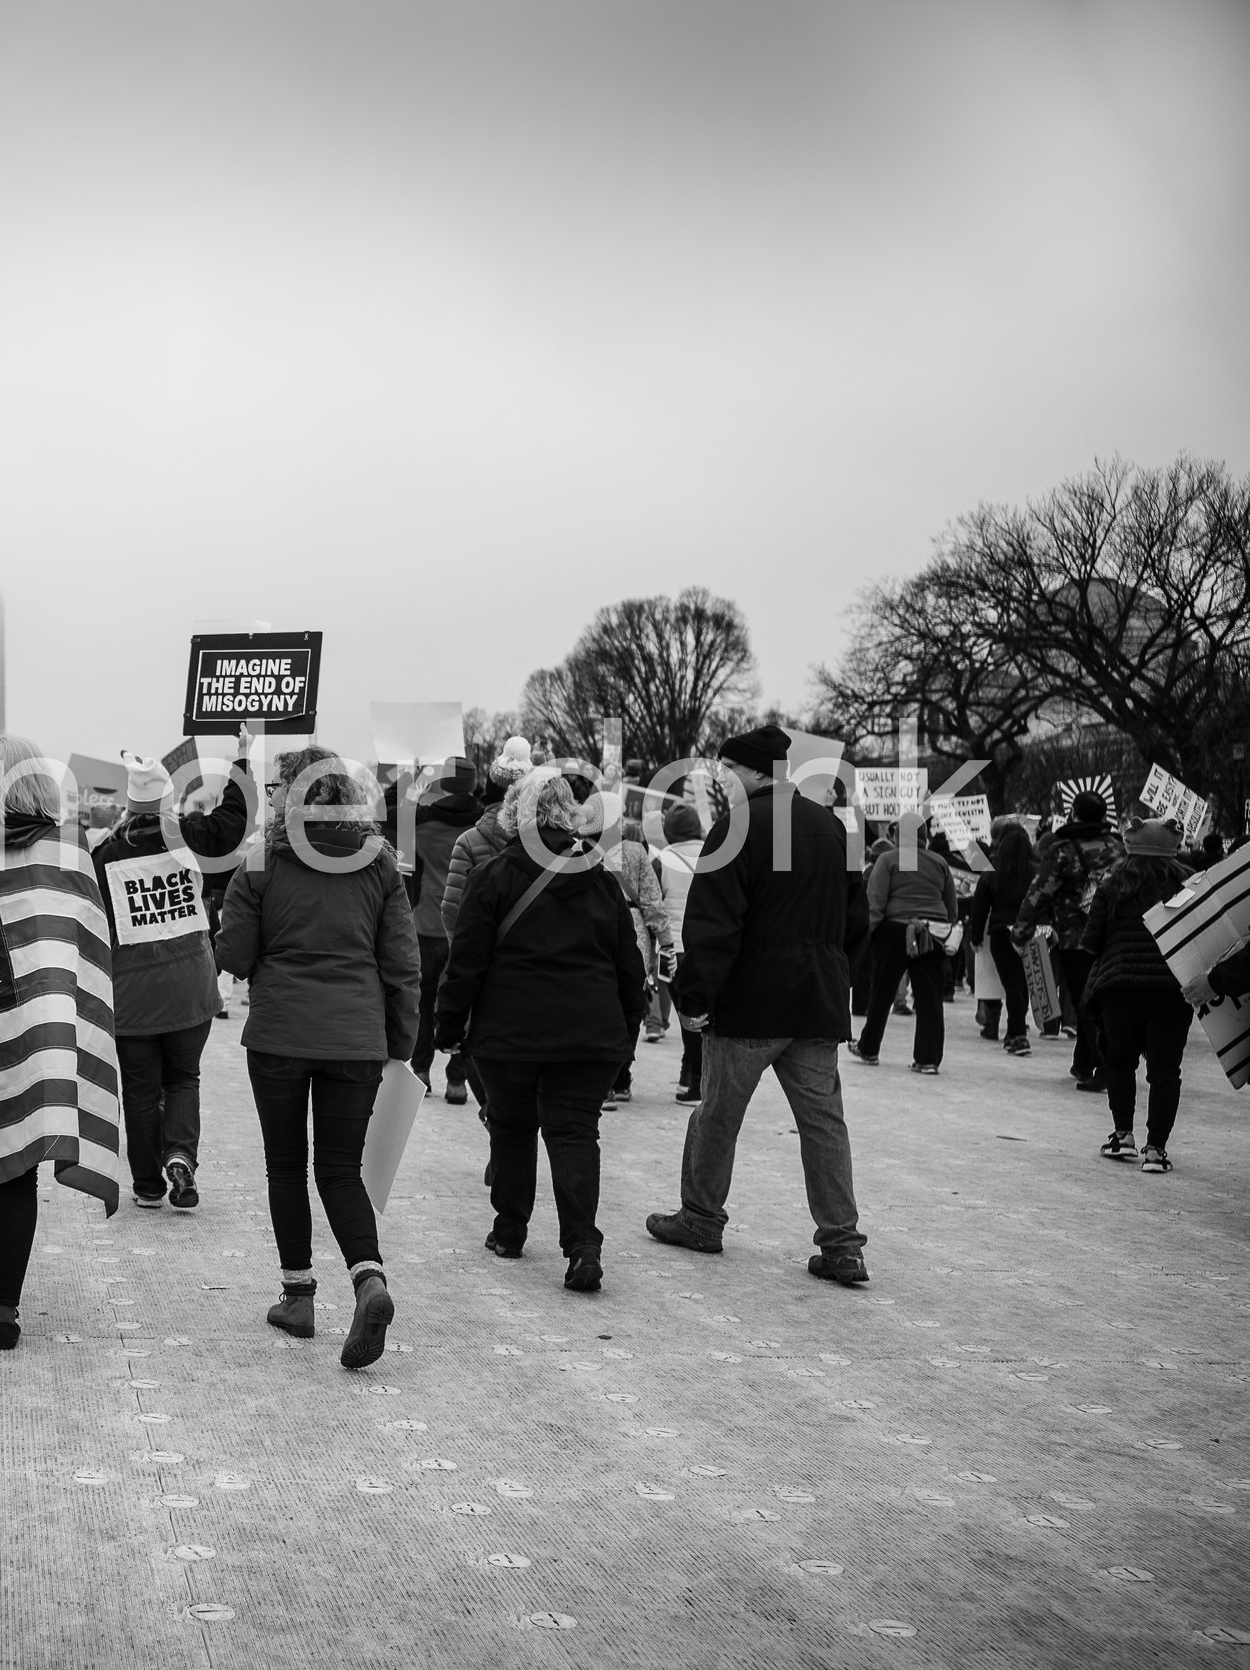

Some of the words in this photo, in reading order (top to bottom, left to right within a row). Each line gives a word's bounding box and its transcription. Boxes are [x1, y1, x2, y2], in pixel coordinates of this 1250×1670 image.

[215, 658, 291, 676] IMAGINE
[200, 677, 236, 694] THE
[239, 677, 276, 694] END
[280, 676, 305, 693] OF
[202, 695, 298, 711] MISOGYNY
[859, 772, 895, 782] USUALLY
[1143, 782, 1159, 803] WILL
[1154, 768, 1164, 781] IT
[874, 786, 897, 798] SIGN
[1156, 800, 1168, 817] BE
[124, 869, 193, 895] BLACK
[127, 885, 195, 914] LIVES
[130, 904, 197, 927] MATTER
